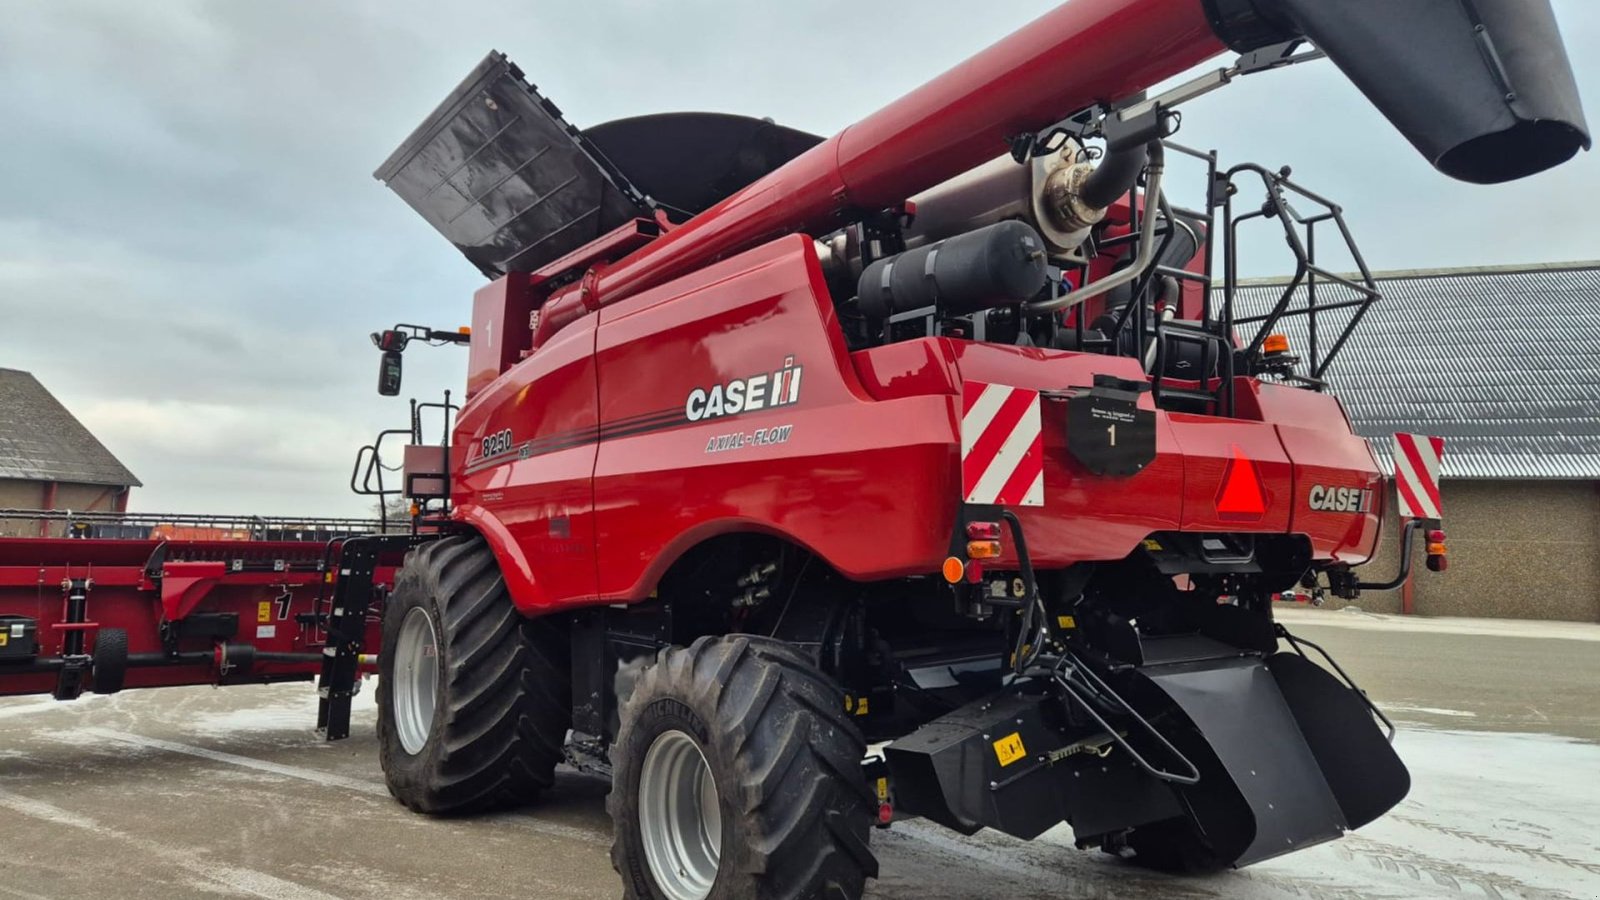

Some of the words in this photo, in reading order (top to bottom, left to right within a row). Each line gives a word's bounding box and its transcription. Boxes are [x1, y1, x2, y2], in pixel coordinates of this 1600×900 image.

[485, 319, 493, 348] 1
[685, 374, 768, 421] CASE
[482, 428, 512, 458] 8250
[704, 424, 793, 453] AXIAL-FLOW
[1107, 424, 1116, 446] 1
[1308, 484, 1360, 512] CASE
[274, 592, 293, 620] 1
